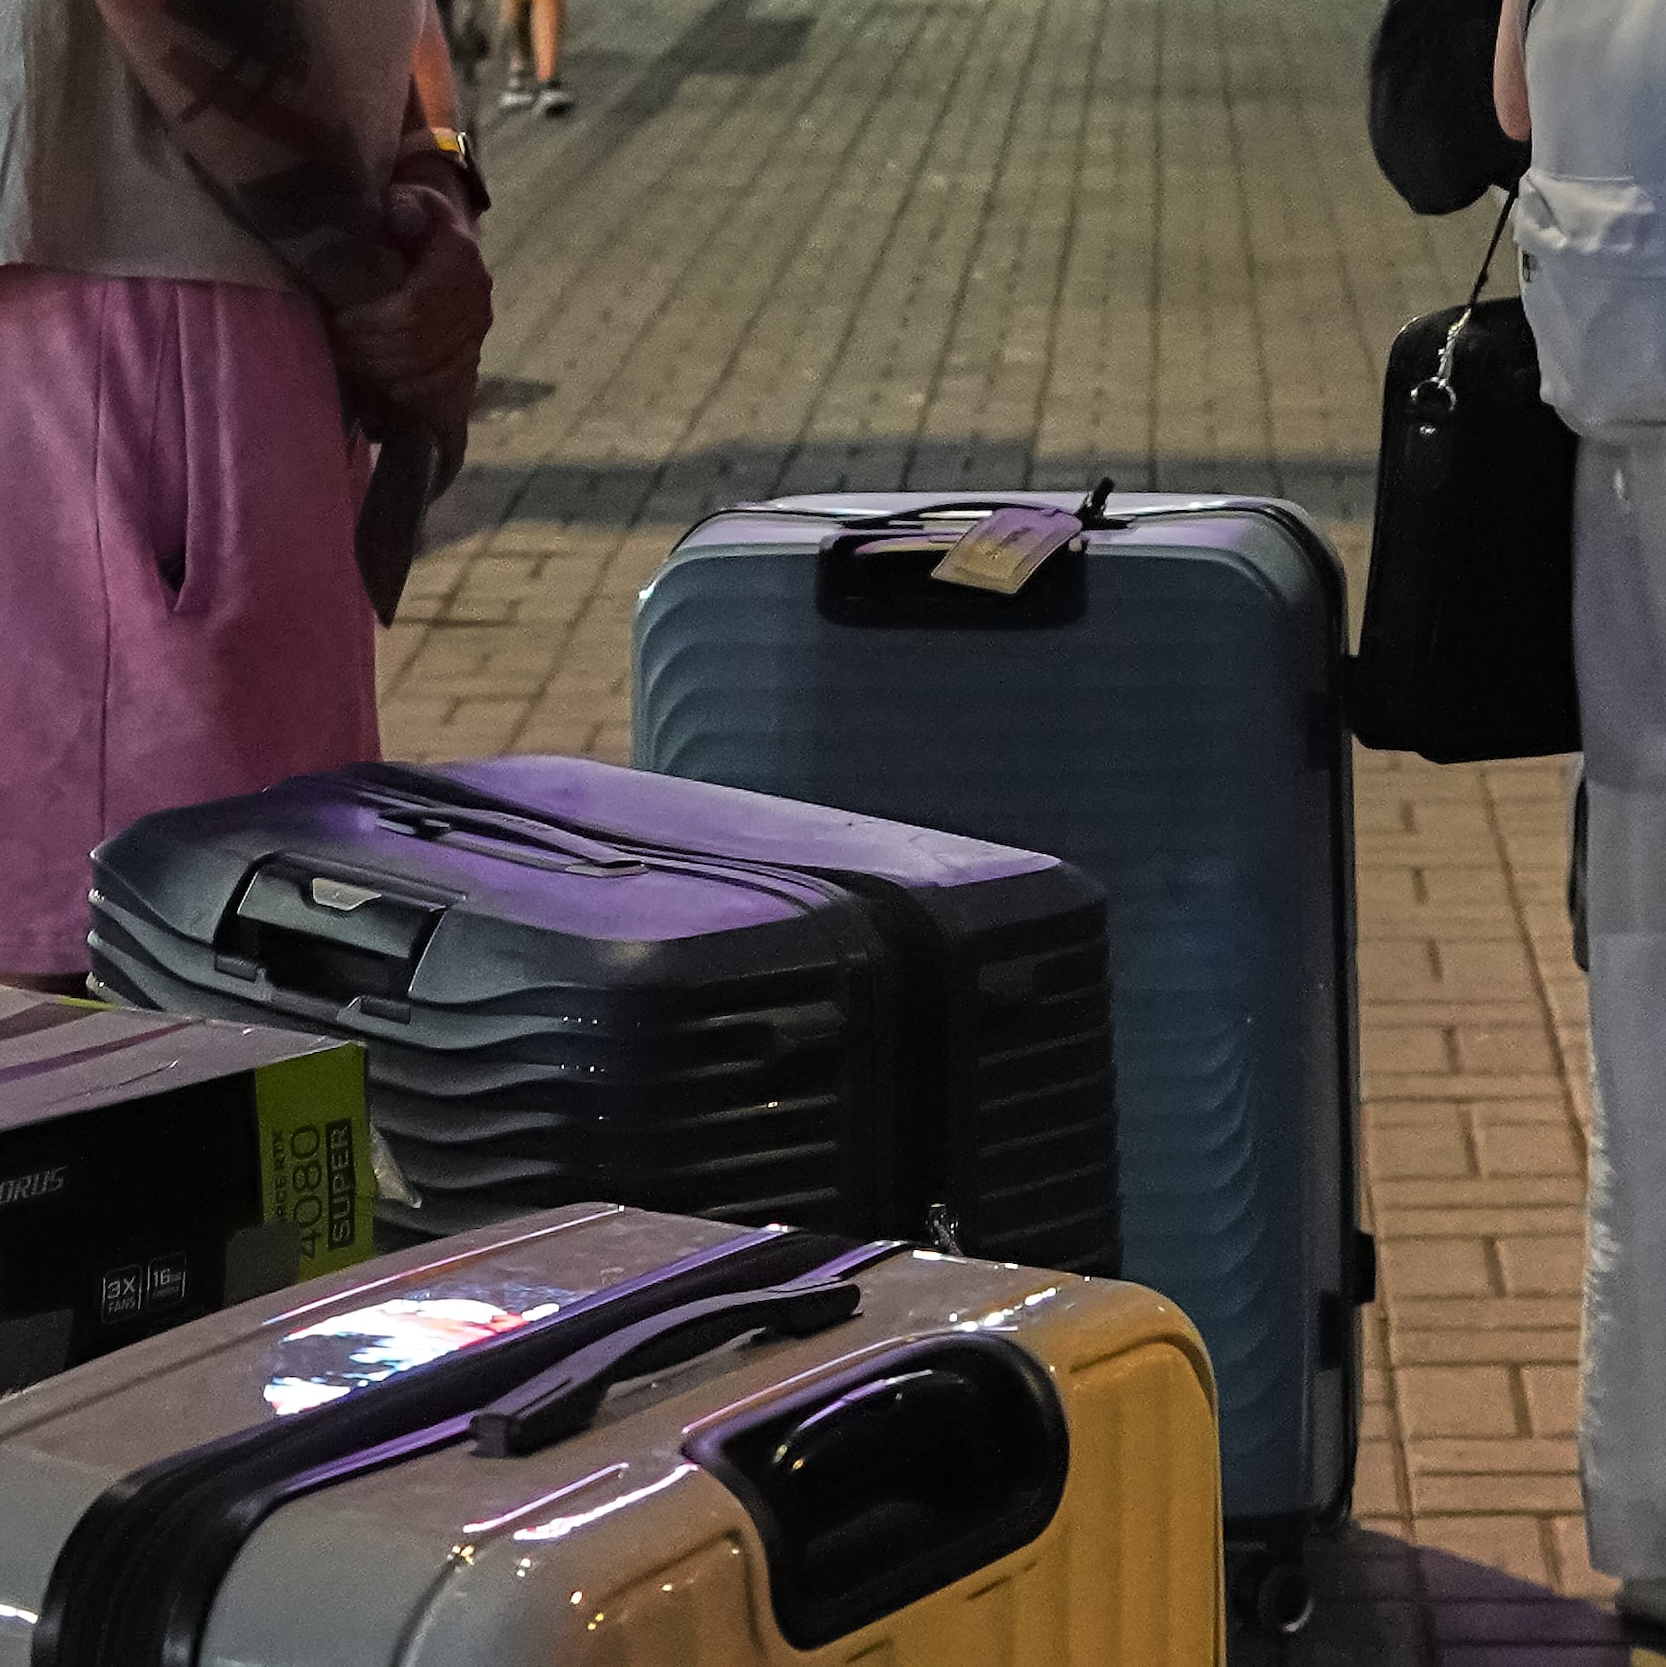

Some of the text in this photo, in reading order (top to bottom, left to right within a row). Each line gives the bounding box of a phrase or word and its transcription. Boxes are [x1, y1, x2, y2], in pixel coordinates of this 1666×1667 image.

[289, 1125, 324, 1259] 4080
[329, 1123, 352, 1243] SUPER
[107, 1276, 136, 1299] 3X
